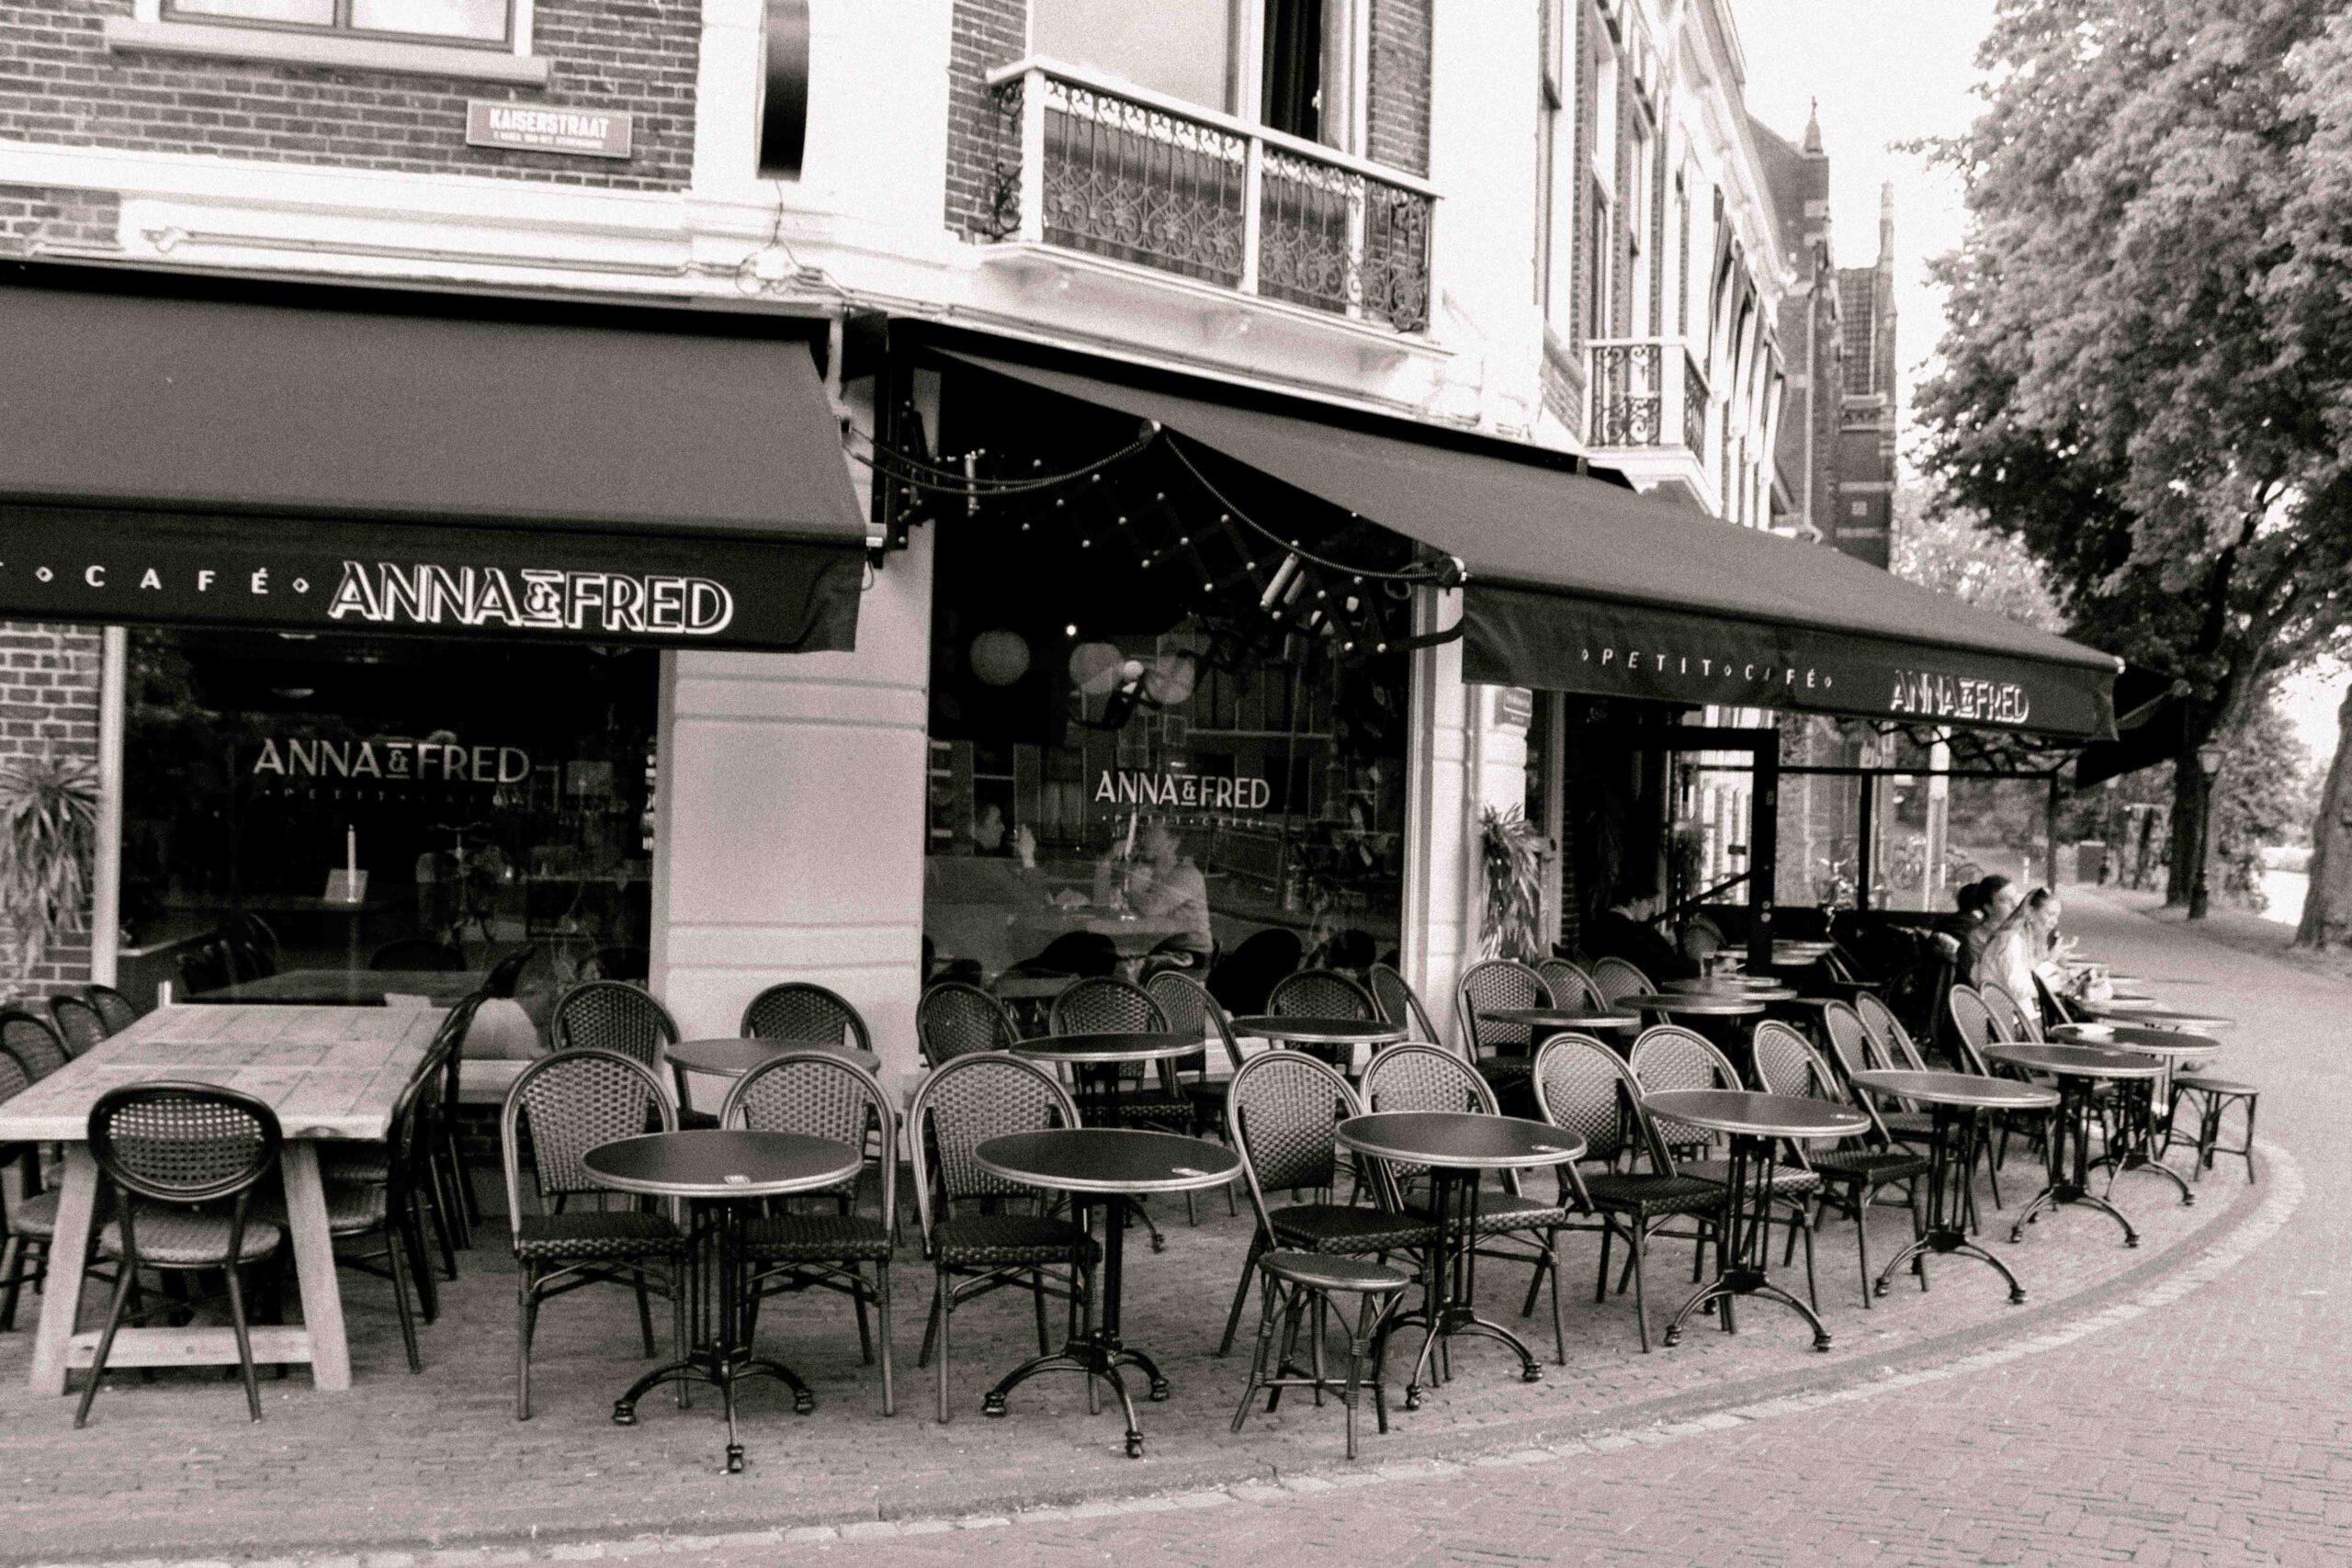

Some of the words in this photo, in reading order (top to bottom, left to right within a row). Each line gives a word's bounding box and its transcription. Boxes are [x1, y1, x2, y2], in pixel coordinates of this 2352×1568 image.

[489, 108, 609, 140] KAISERSTRAAT
[85, 565, 269, 594] CAFÉ
[1601, 648, 1713, 677] PETIT
